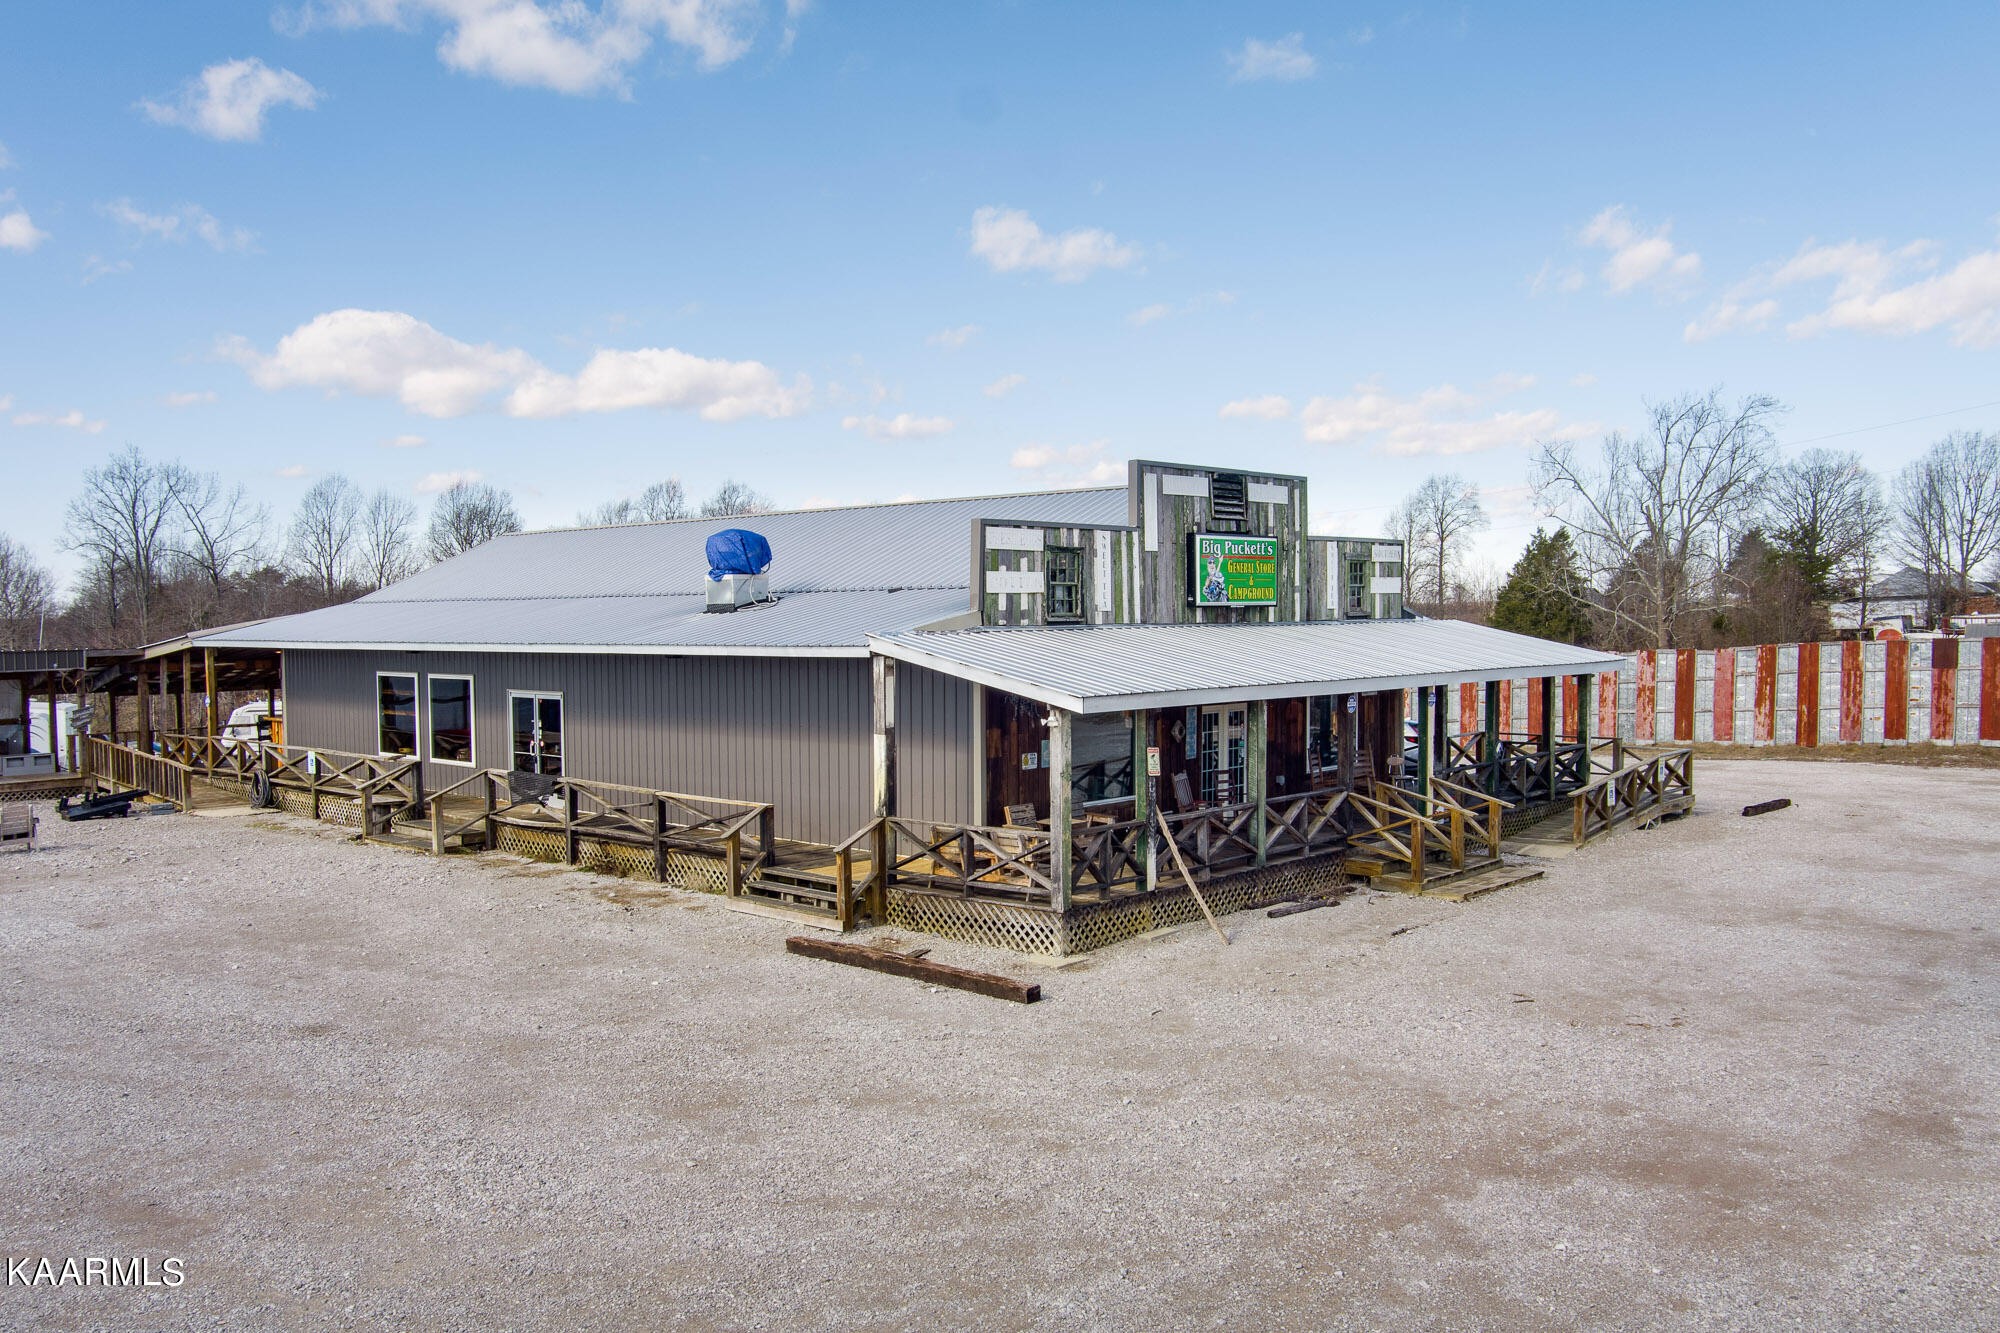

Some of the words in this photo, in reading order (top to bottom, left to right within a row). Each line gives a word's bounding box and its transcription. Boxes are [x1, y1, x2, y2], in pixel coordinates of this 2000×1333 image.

[1202, 540, 1221, 557] Big
[1225, 541, 1273, 555] Puckett's
[1227, 560, 1254, 573] GENERAL
[1256, 560, 1275, 574] STORE
[1249, 575, 1254, 586] &
[1228, 584, 1274, 600] CAMPGROUND
